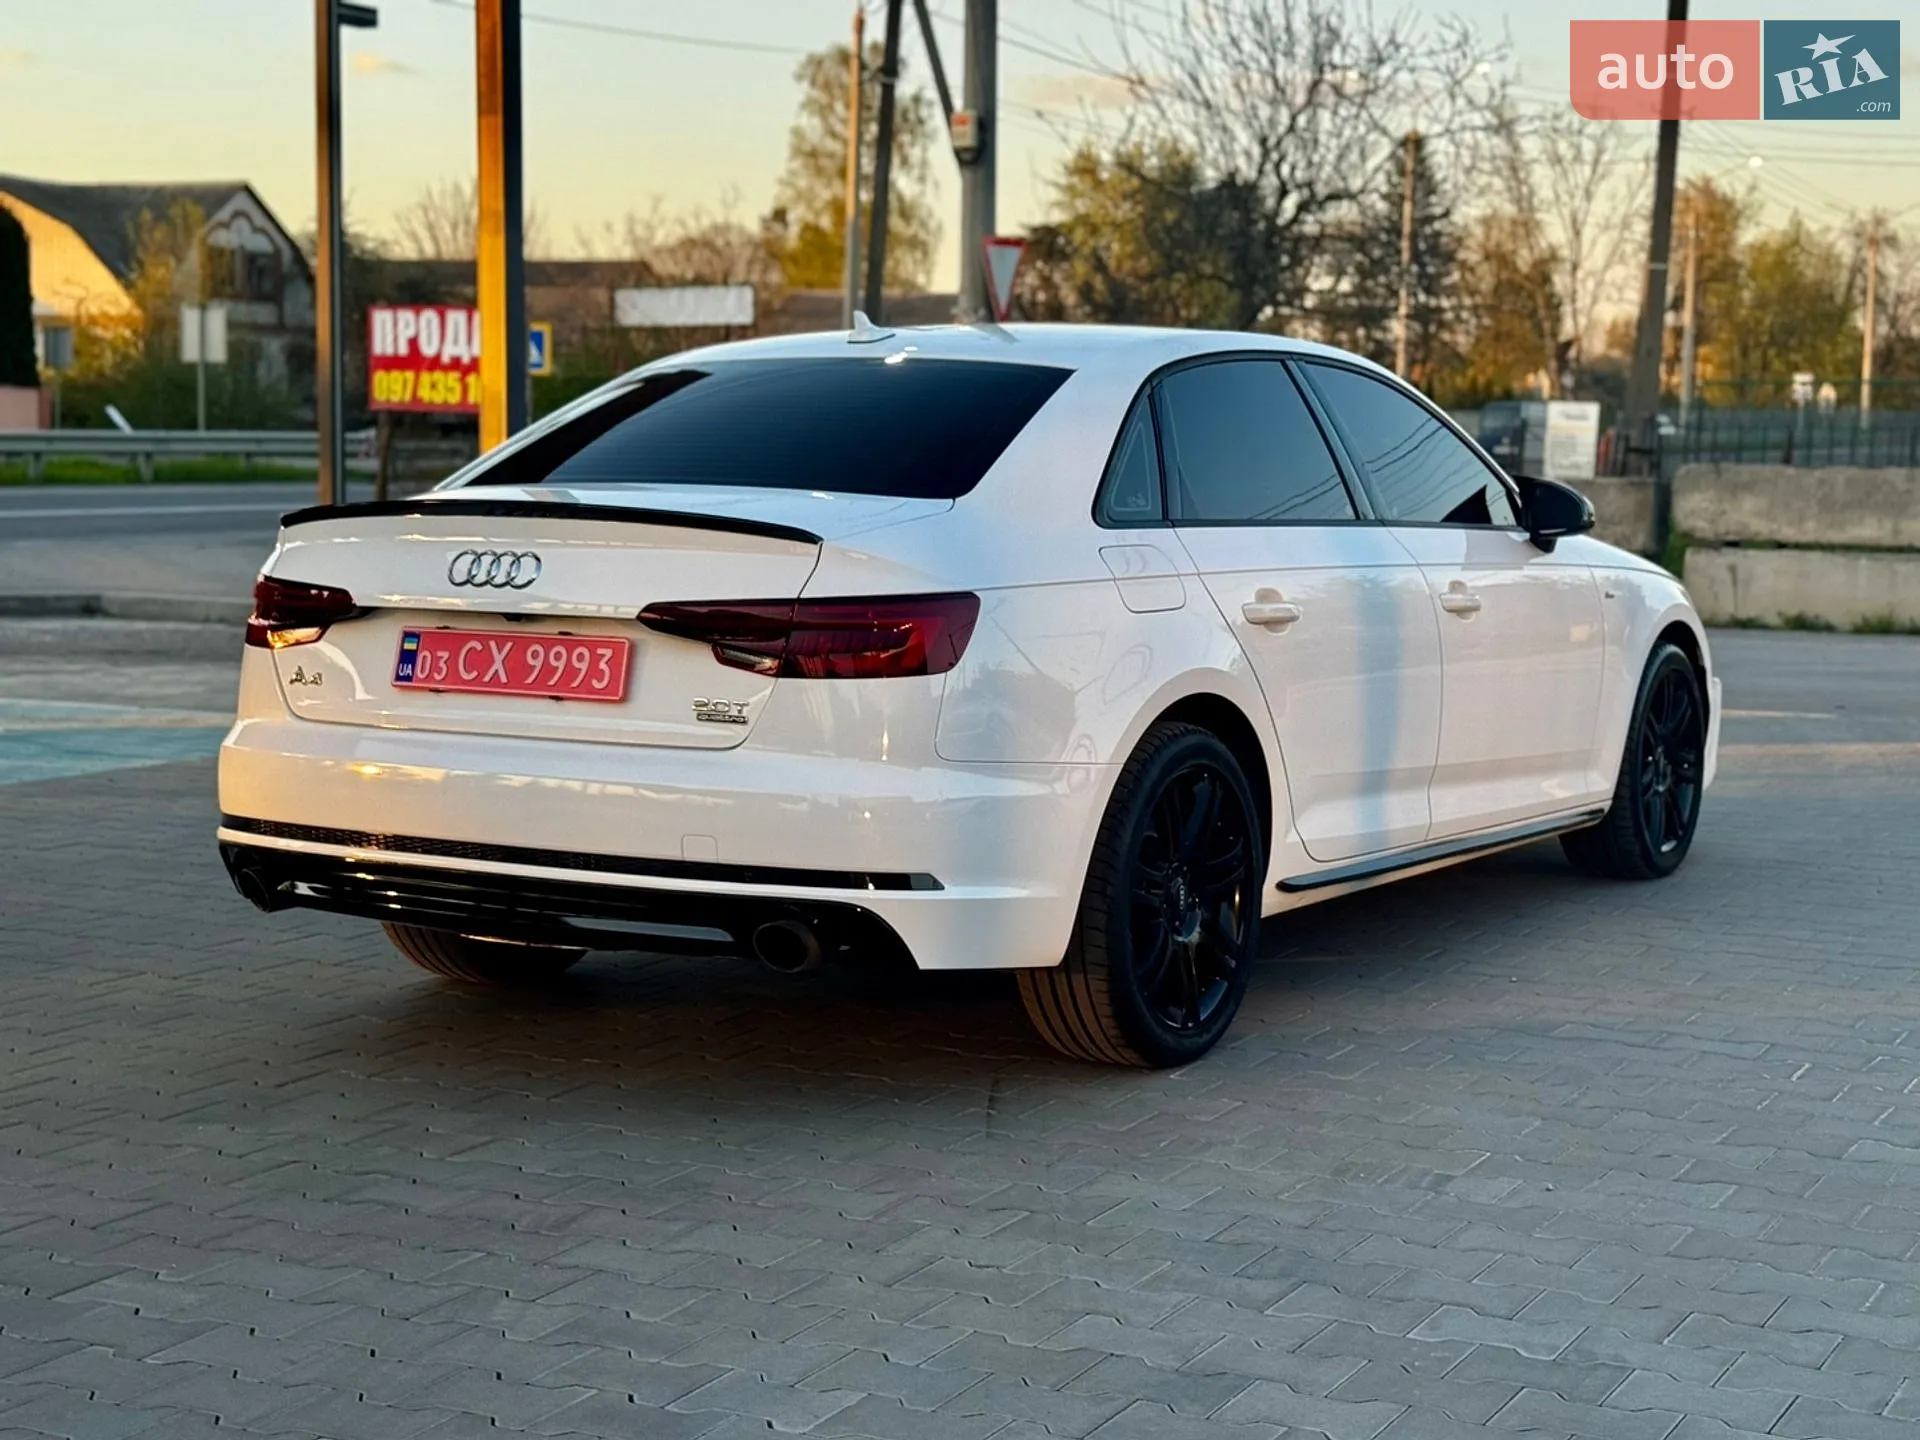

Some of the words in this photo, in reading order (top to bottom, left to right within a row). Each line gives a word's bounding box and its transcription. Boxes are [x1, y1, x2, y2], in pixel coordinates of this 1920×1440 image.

[373, 370, 416, 403] 097
[417, 370, 463, 405] 435
[398, 662, 413, 677] UA
[417, 650, 450, 682] 03
[458, 640, 514, 685] CX
[523, 643, 614, 690] 9993
